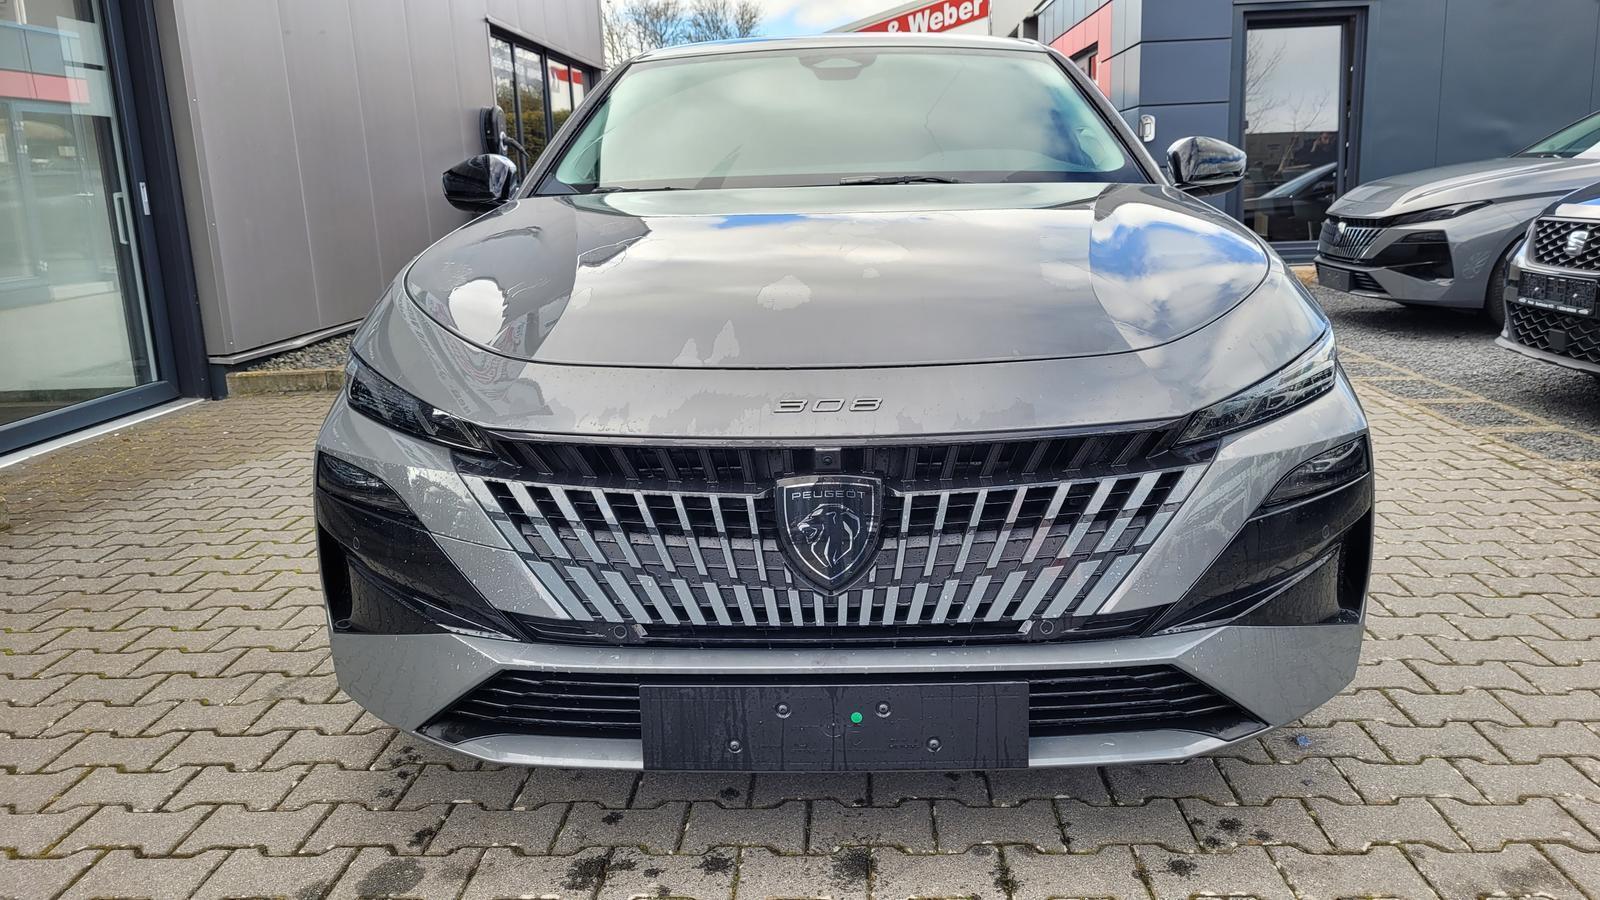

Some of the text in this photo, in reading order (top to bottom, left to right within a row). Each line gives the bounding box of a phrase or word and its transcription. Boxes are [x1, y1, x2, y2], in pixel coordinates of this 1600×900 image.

[907, 0, 984, 32] Weber
[773, 398, 883, 413] 308
[791, 490, 866, 500] PEUGEOT
